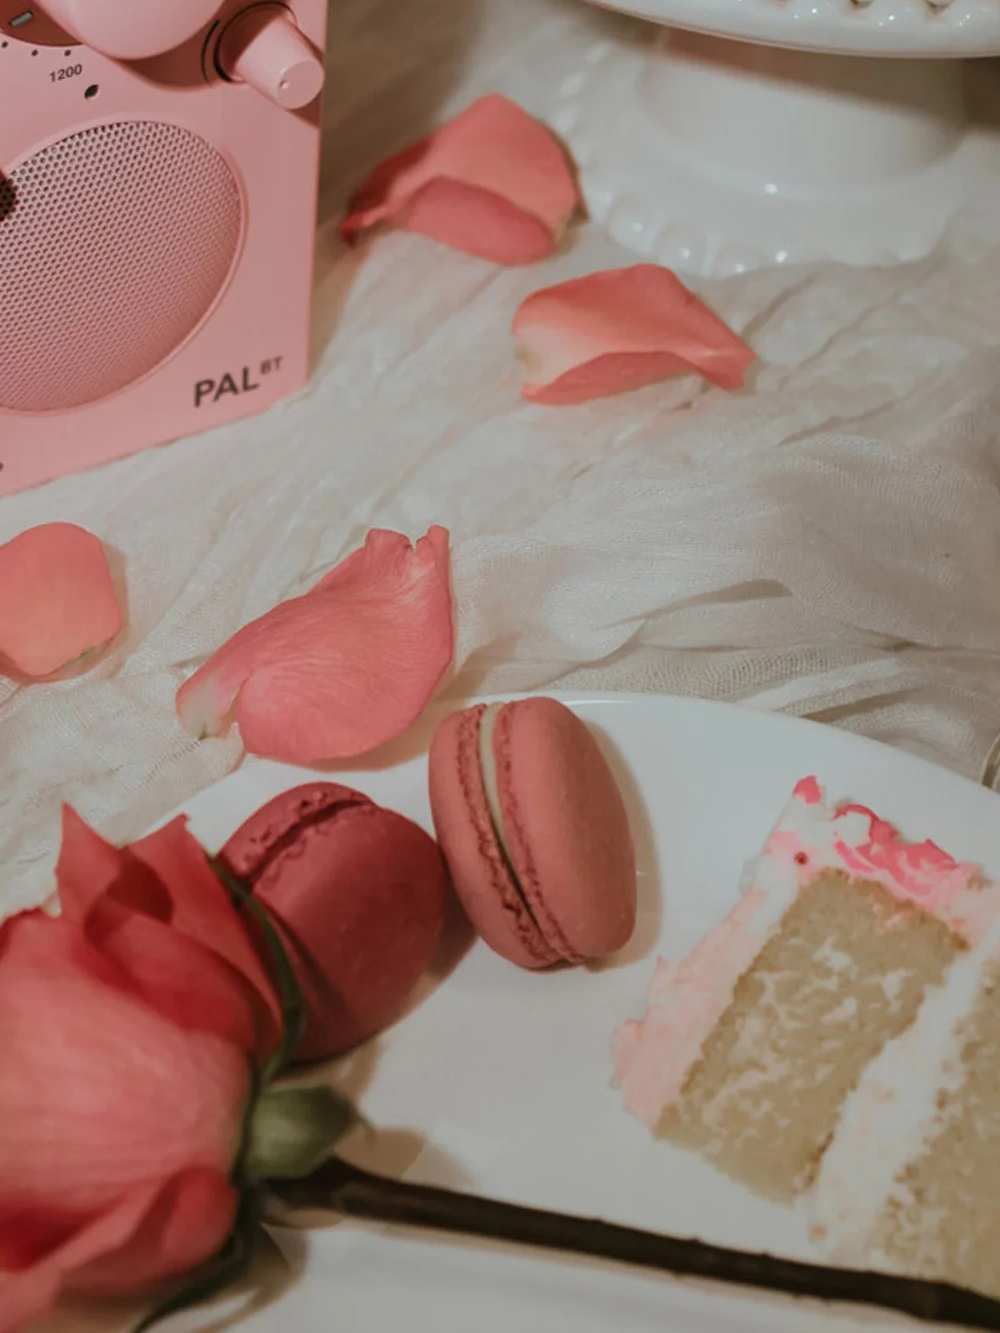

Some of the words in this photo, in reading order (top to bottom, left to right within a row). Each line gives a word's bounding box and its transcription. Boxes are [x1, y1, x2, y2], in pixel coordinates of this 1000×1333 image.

[49, 63, 83, 83] 1200
[194, 366, 260, 408] PAL
[260, 355, 284, 374] BT
